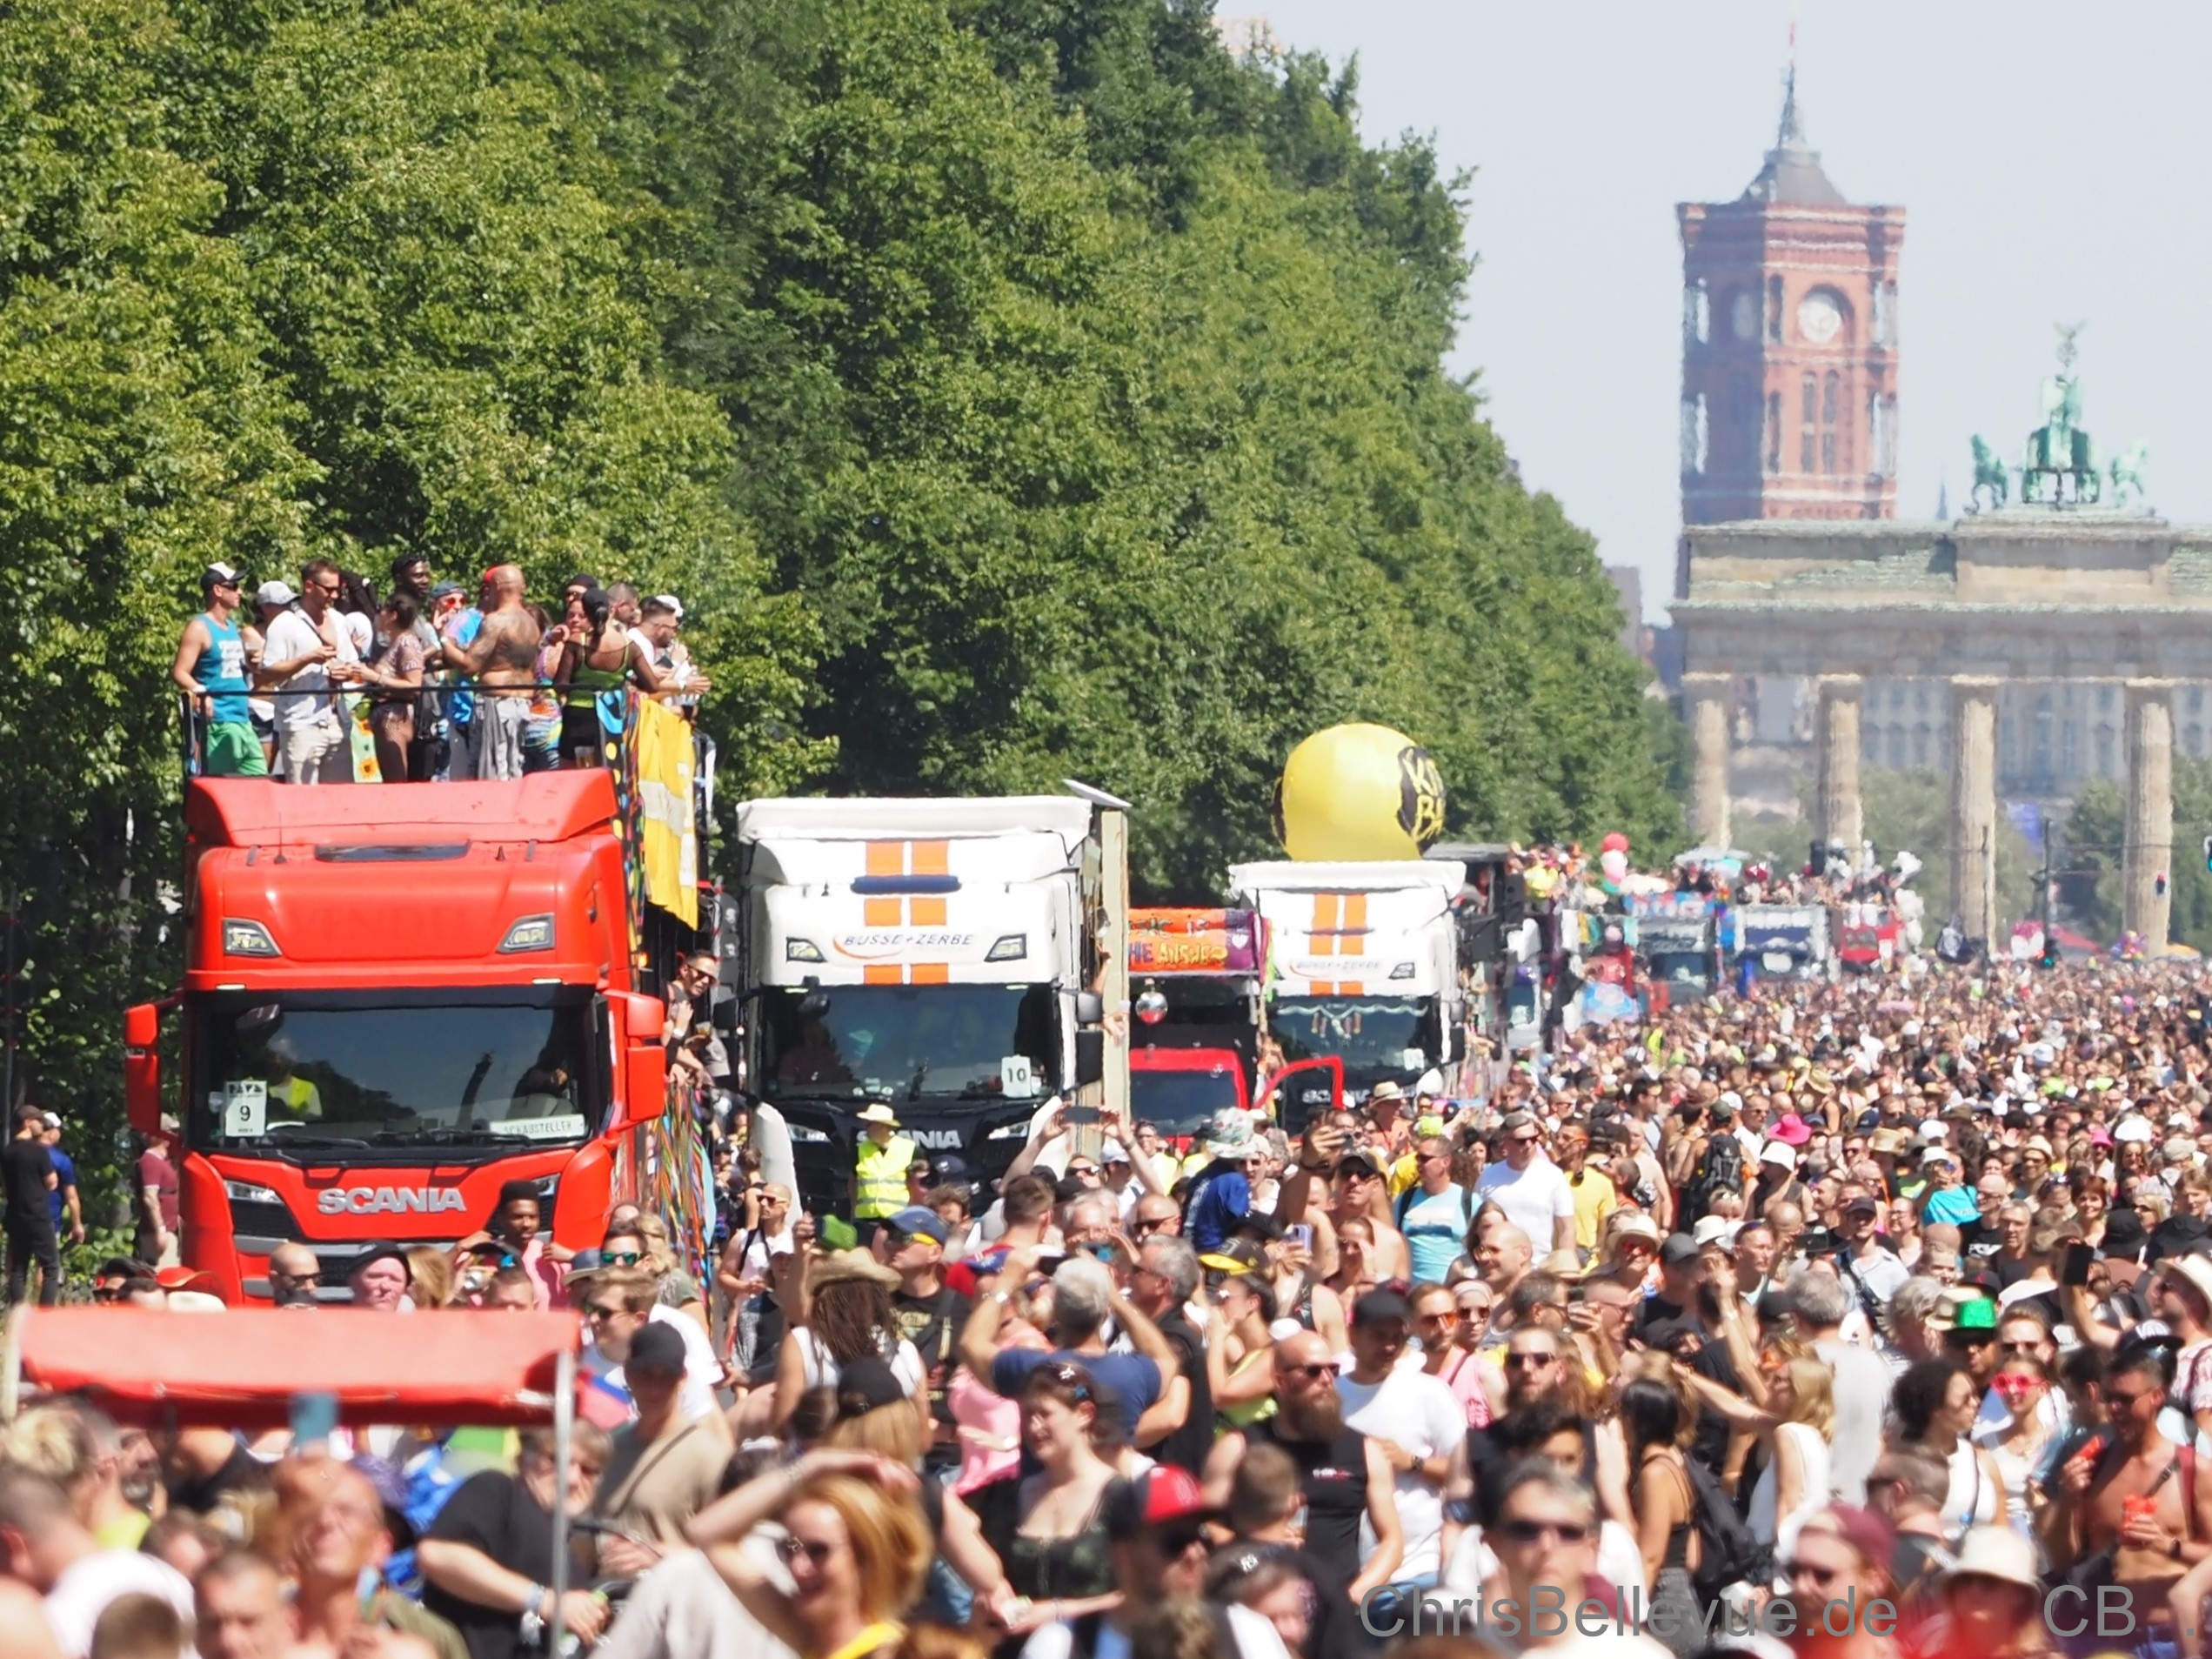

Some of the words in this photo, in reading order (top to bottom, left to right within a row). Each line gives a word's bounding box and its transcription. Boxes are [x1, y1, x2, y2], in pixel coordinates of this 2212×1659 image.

[1126, 940, 1154, 964] HE
[1007, 1067, 1026, 1083] 10
[239, 1105, 251, 1122] 9
[317, 1187, 467, 1214] SCANIA
